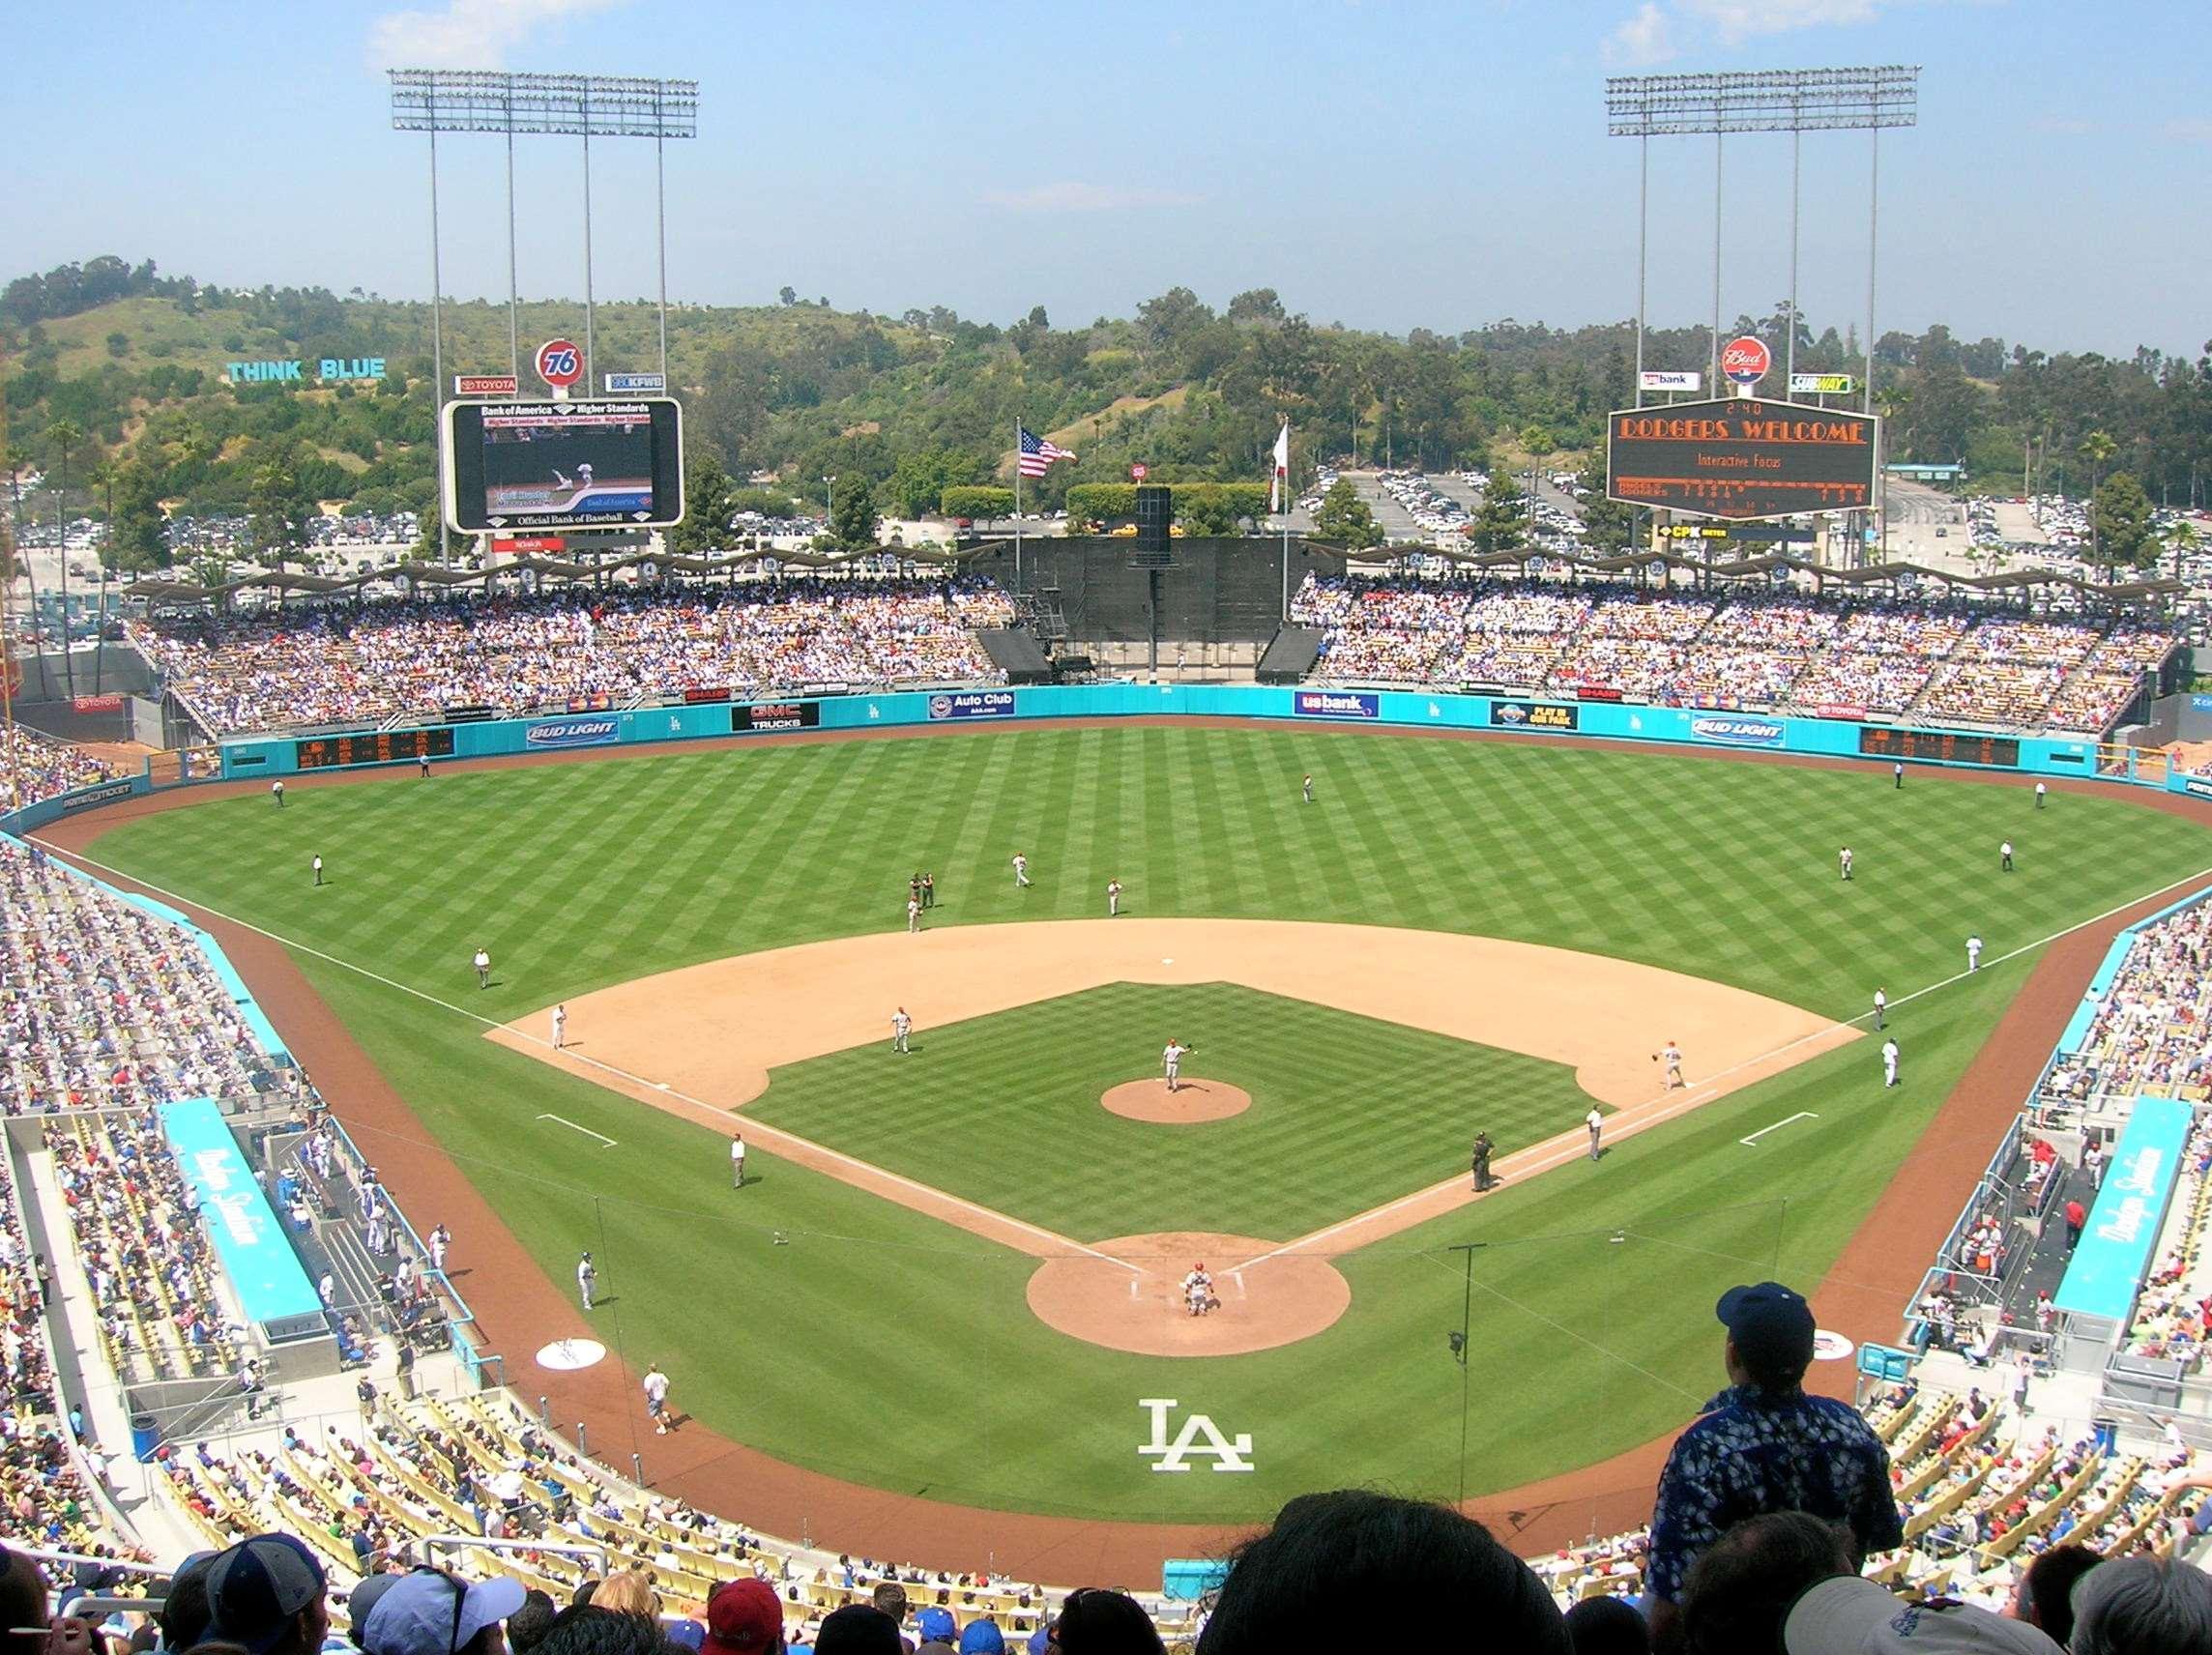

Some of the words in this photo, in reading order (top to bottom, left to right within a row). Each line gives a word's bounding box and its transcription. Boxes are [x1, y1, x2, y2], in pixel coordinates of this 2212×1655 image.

[544, 349, 577, 376] 76
[1726, 350, 1763, 365] Bud
[226, 361, 302, 382] THINK
[321, 358, 386, 379] BLUE
[475, 380, 515, 391] TOYOTA
[628, 376, 662, 388] KFWB
[1660, 375, 1686, 384] bank
[1795, 376, 1844, 391] SUBWAY
[481, 406, 505, 417] Bank
[505, 406, 514, 416] of
[514, 405, 553, 416] America
[577, 404, 605, 415] Higher
[605, 403, 650, 414] Standards
[1619, 418, 1730, 439] DODGERS
[1742, 420, 1865, 442] WELCOME
[1698, 452, 1749, 468] Interactive
[1754, 453, 1782, 469] Focus
[517, 514, 550, 526] Official
[551, 513, 574, 524] Bank
[575, 512, 585, 523] of
[585, 512, 624, 523] Baseball
[954, 695, 982, 707] Auto
[983, 693, 1012, 705] Club
[750, 704, 802, 717] GMC
[529, 727, 567, 739] BUD
[568, 722, 617, 737] LIGHT
[750, 718, 801, 730] TRUCKS
[1694, 720, 1732, 733] BUD
[1732, 723, 1782, 738] LIGHT
[1138, 1399, 1255, 1470] LA
